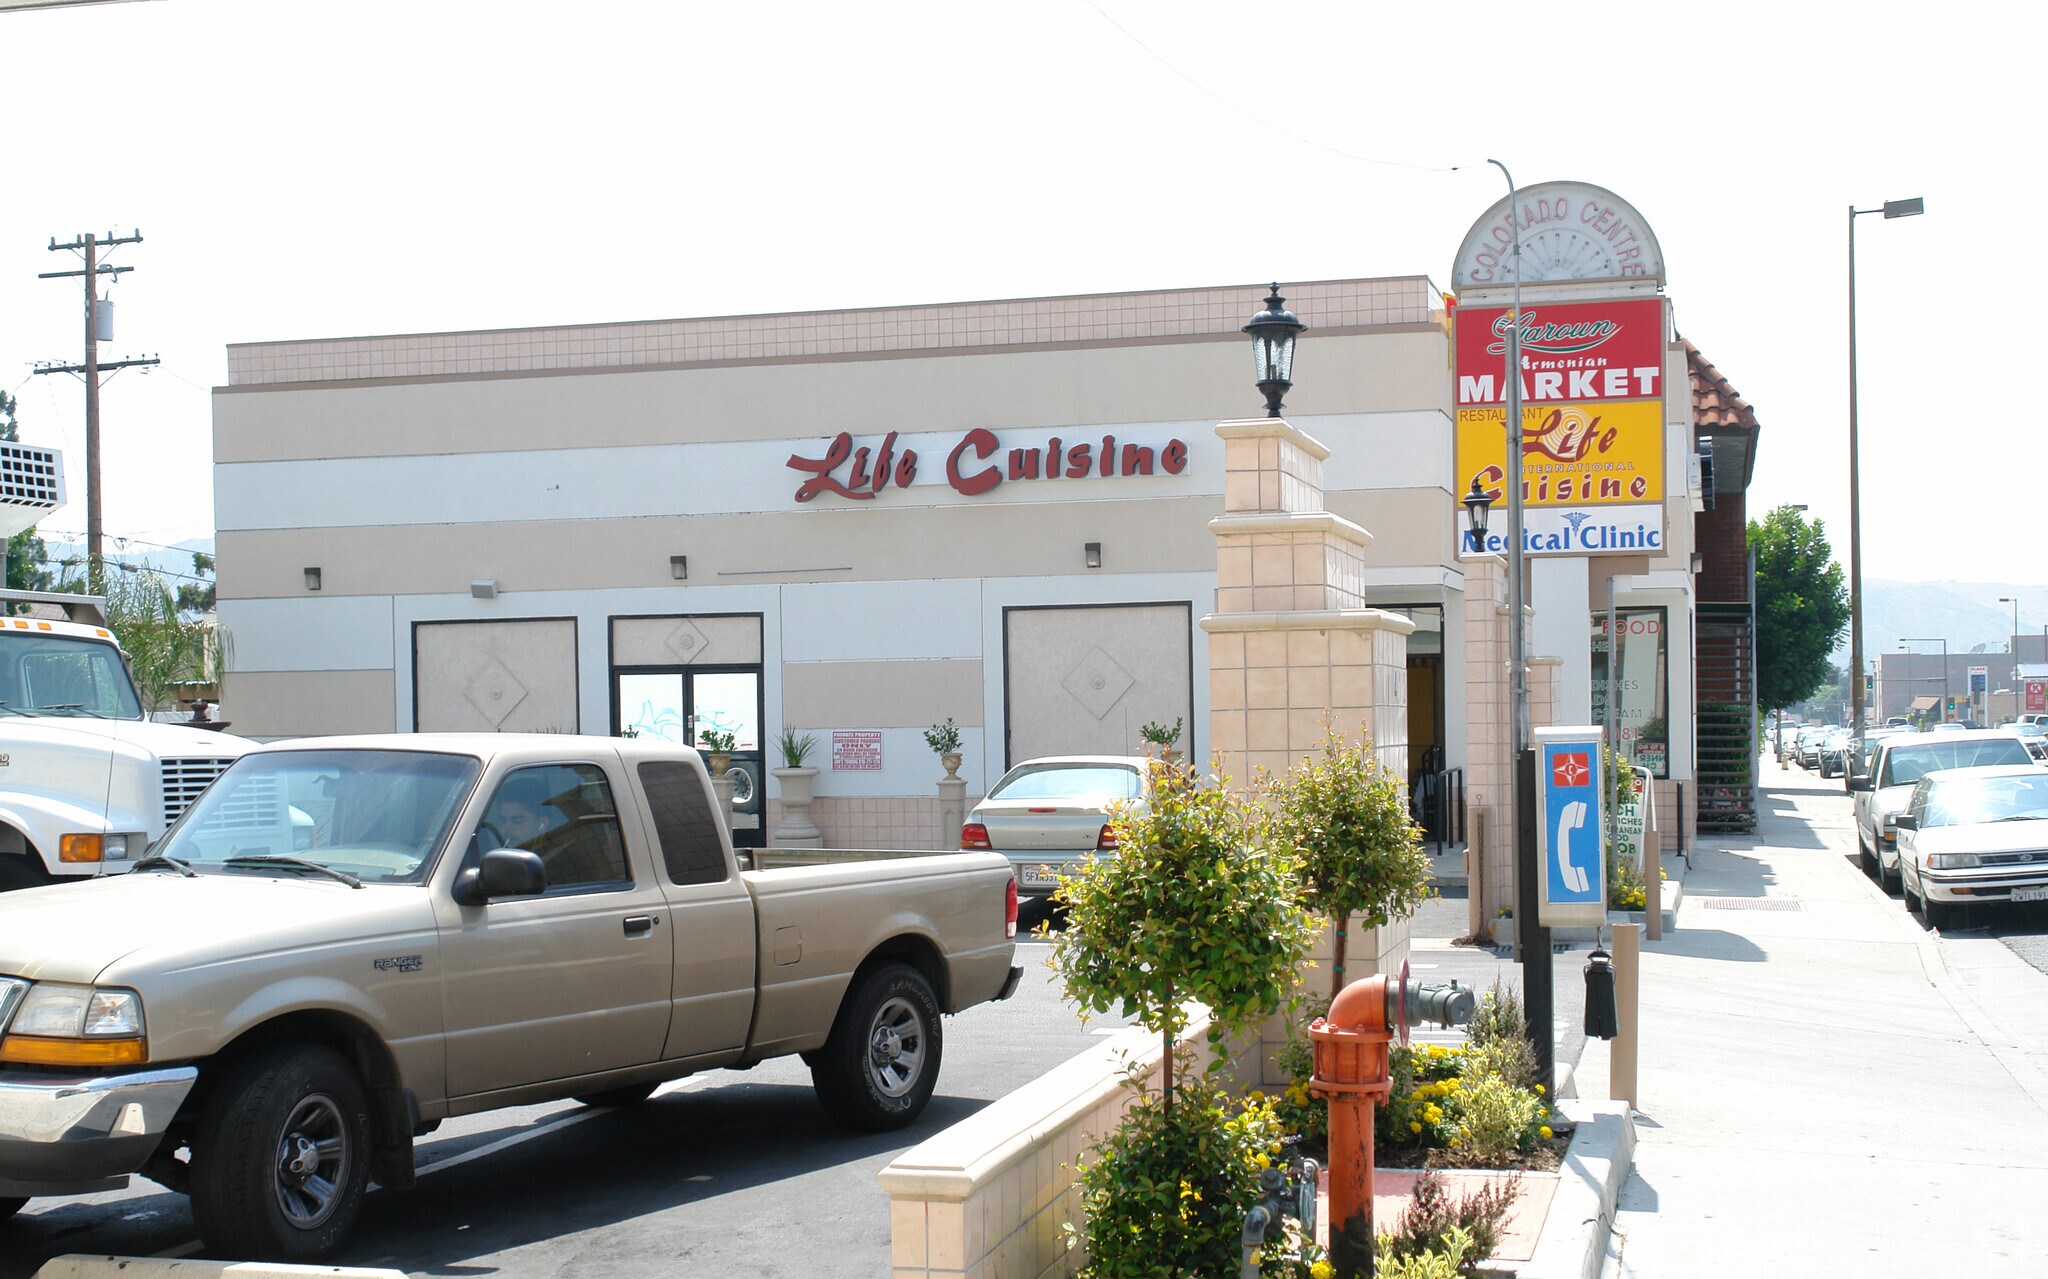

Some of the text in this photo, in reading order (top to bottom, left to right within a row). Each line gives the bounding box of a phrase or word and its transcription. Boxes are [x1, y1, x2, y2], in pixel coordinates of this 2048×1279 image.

[1470, 198, 1646, 282] COLORADO CENTRE
[1521, 355, 1607, 370] Armenian
[1459, 367, 1660, 403] MARKET
[1460, 407, 1544, 422] RESTAUANT
[1500, 408, 1617, 462] Life
[786, 428, 1188, 503] Life Cuisine
[1522, 462, 1635, 474] TERNATIONAL
[1462, 525, 1661, 552] Meical Clinic
[1602, 620, 1660, 635] FOOD
[374, 955, 423, 970] RANGER
